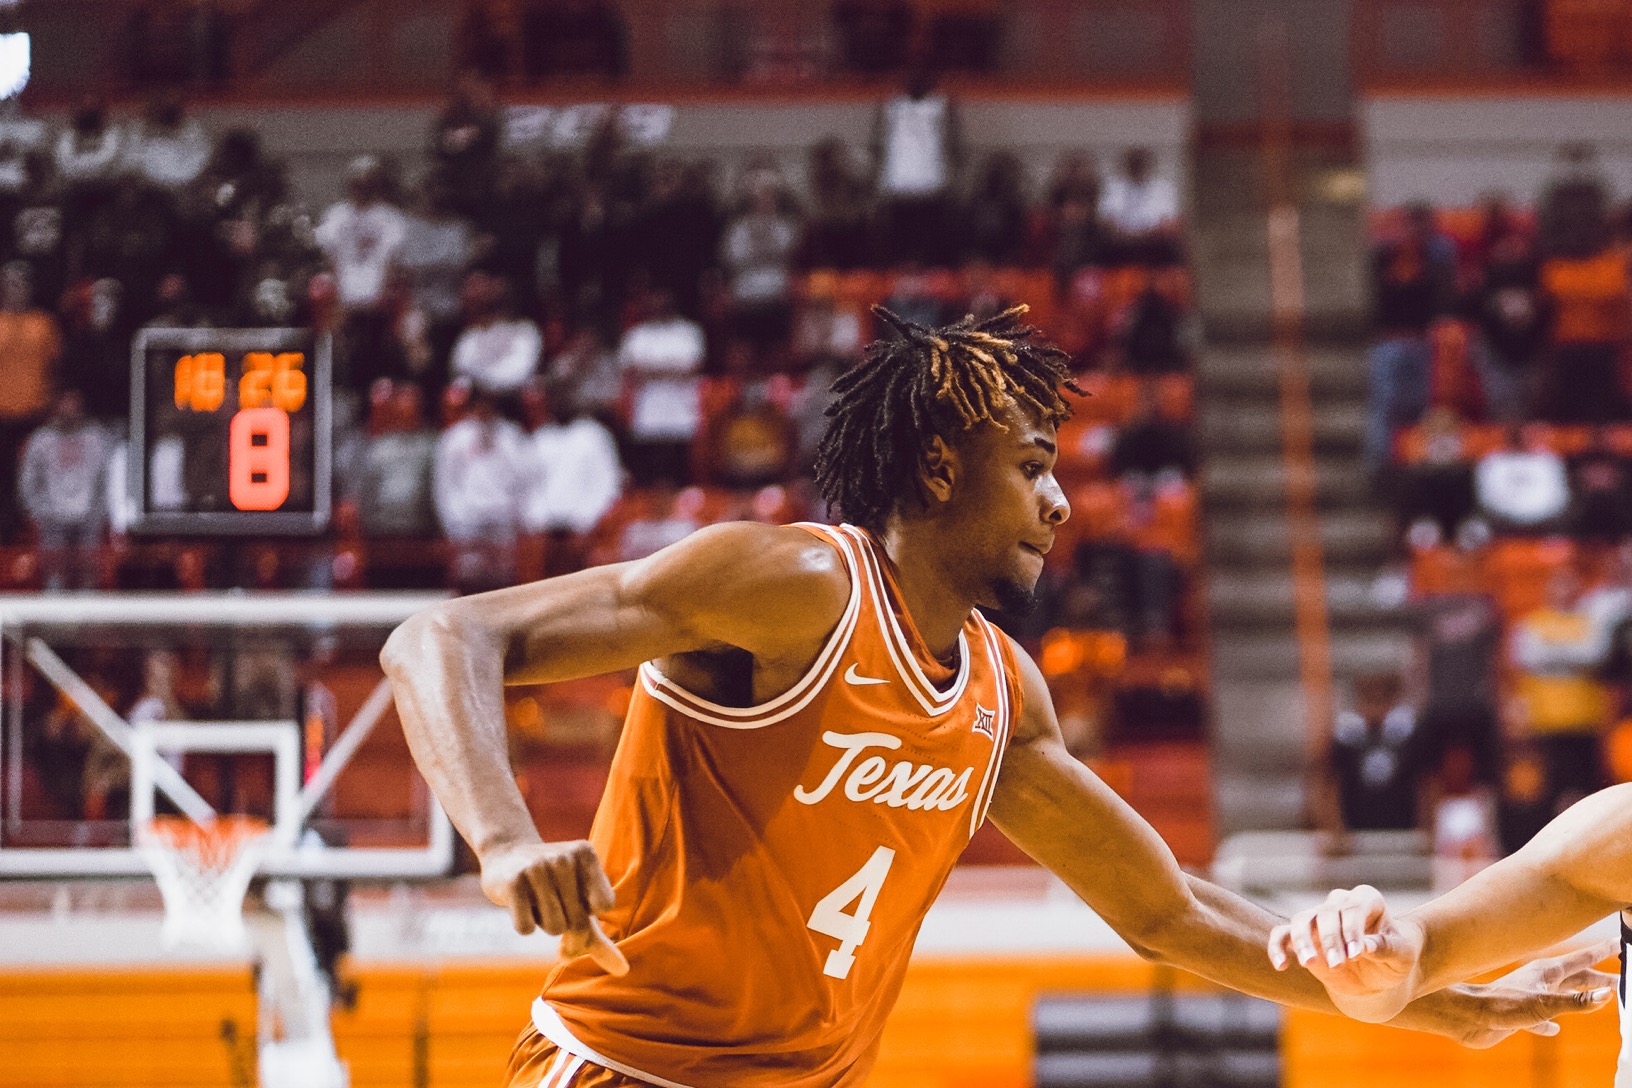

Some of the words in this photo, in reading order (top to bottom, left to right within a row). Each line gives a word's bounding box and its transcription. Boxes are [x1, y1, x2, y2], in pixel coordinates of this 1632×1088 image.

[229, 408, 290, 511] 8
[794, 730, 974, 811] Texas
[806, 845, 896, 980] 4
